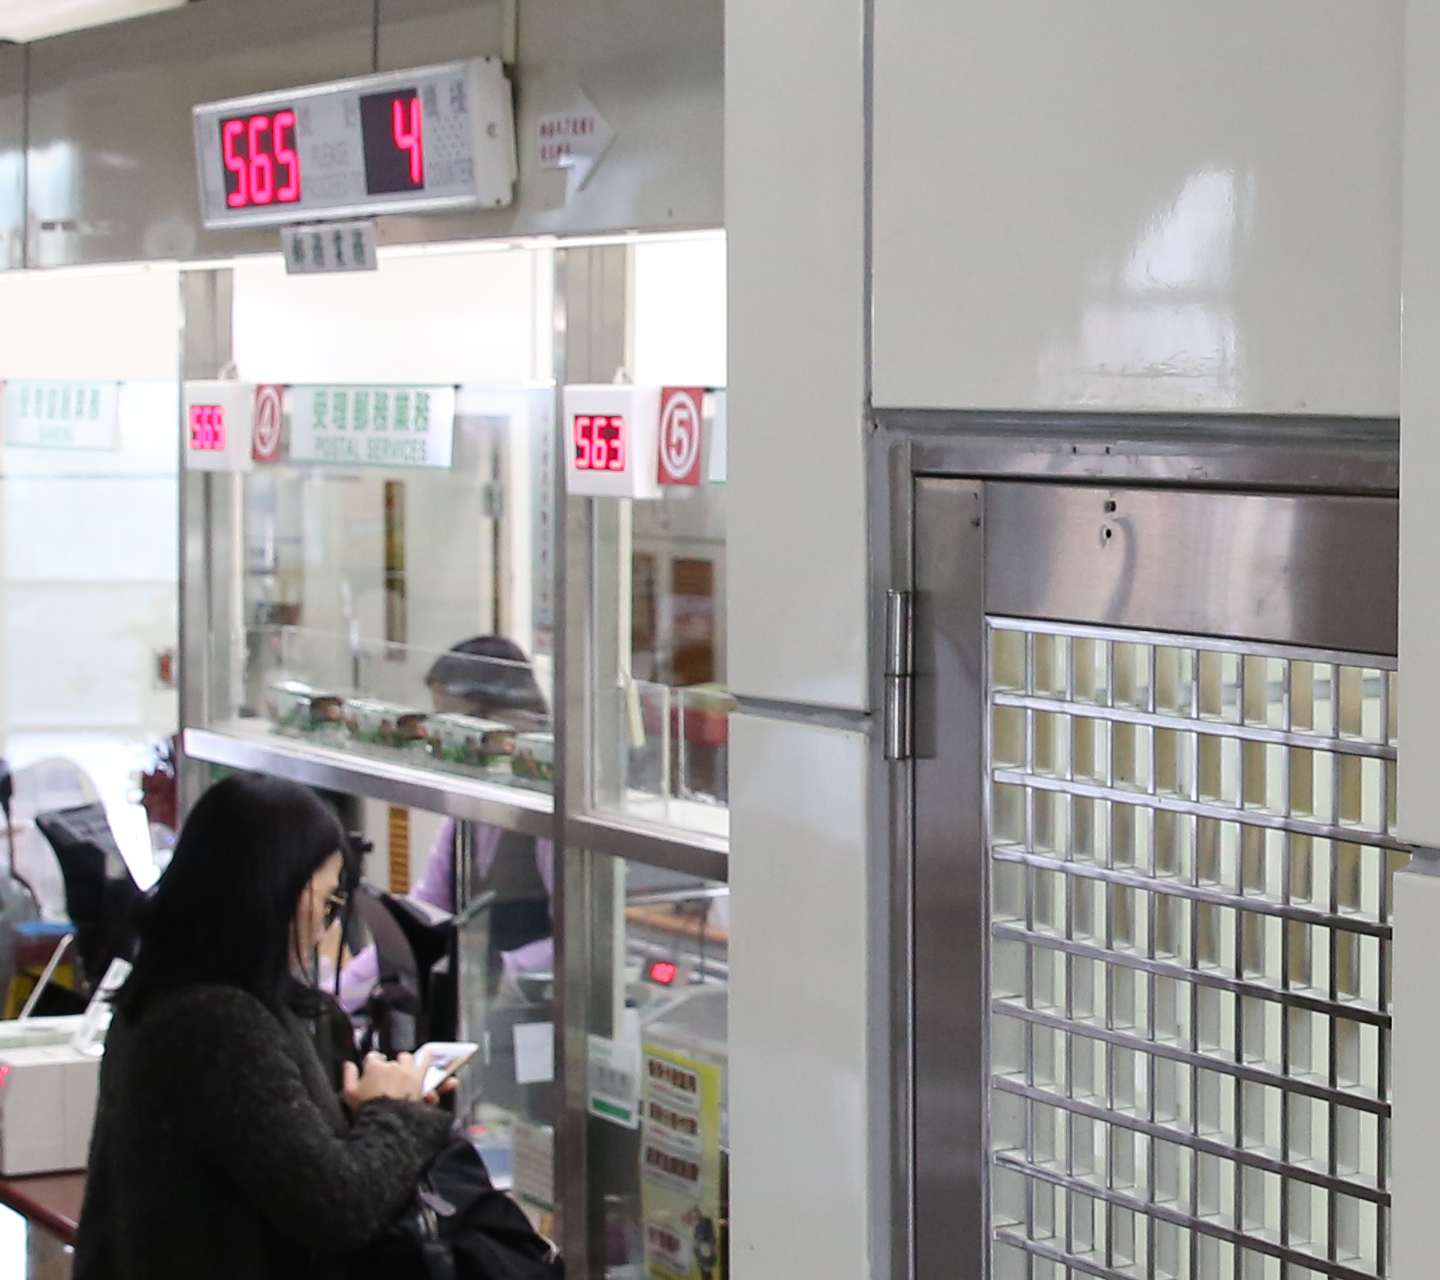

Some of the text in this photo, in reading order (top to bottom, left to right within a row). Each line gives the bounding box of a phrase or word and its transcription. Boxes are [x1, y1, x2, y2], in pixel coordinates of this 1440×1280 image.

[223, 110, 301, 208] 565
[392, 97, 423, 184] 4
[574, 416, 626, 470] 563
[671, 408, 689, 466] 5
